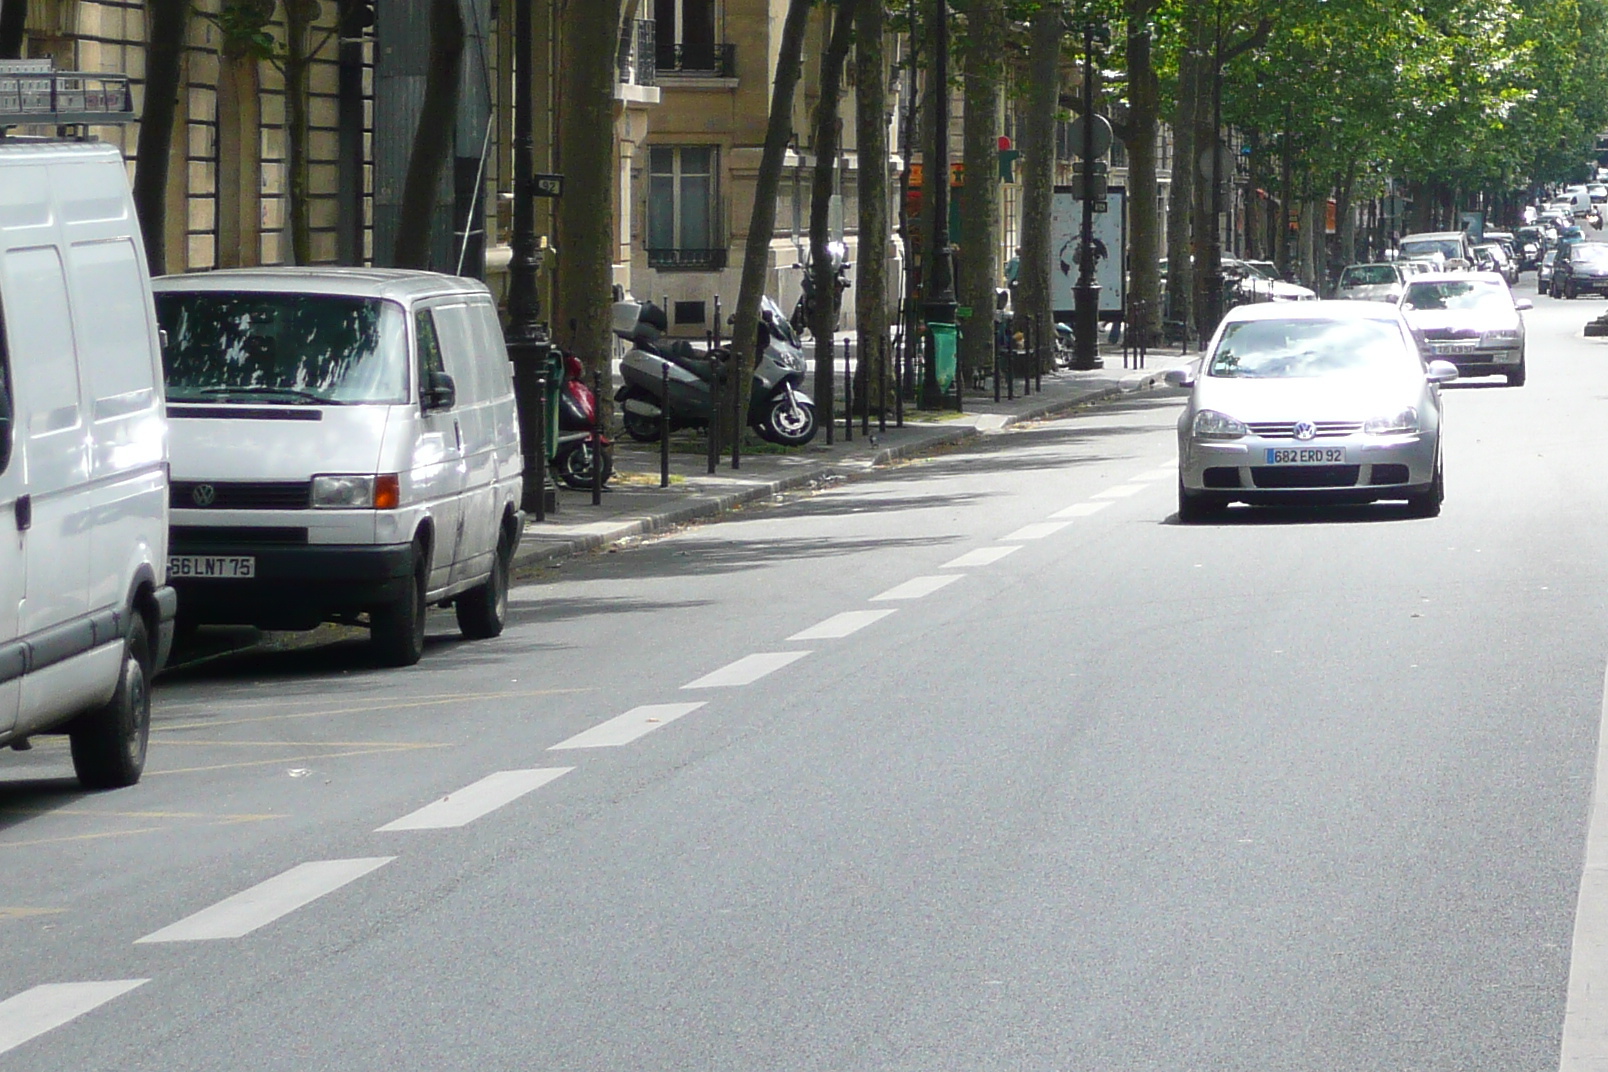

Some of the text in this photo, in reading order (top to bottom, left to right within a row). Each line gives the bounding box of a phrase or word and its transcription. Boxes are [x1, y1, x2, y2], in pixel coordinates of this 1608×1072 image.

[542, 180, 556, 192] 92
[1274, 449, 1342, 463] 682 ERD 92
[170, 557, 250, 576] 56 LNT 75
